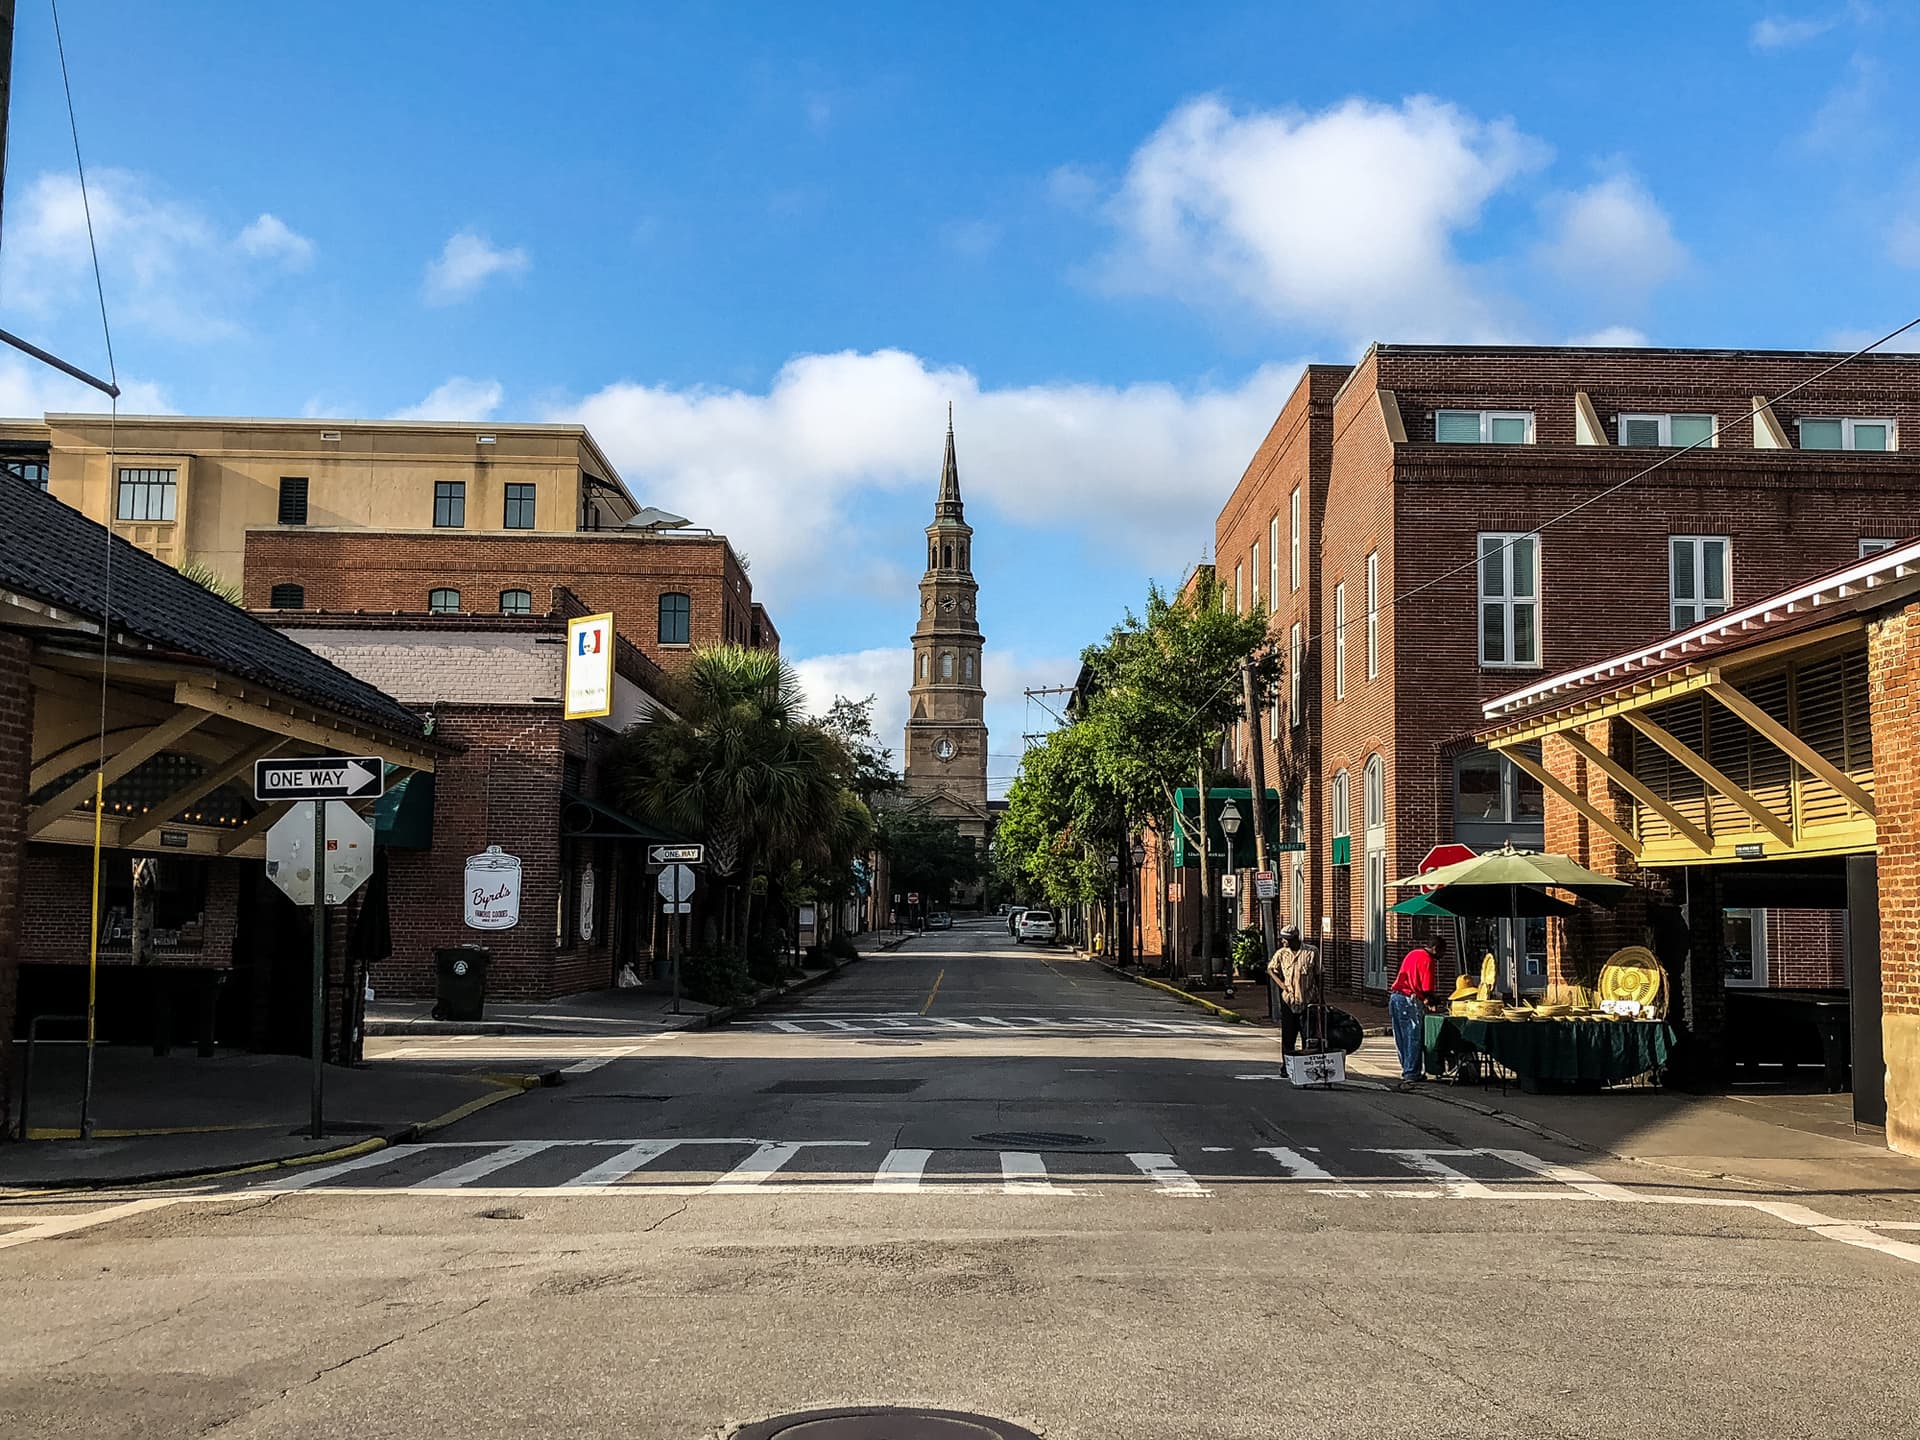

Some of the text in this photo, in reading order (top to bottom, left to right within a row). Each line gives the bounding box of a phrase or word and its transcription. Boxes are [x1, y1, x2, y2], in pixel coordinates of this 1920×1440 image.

[270, 770, 344, 787] ONE WAY
[664, 850, 680, 858] ONE
[472, 883, 511, 910] Byrd's
